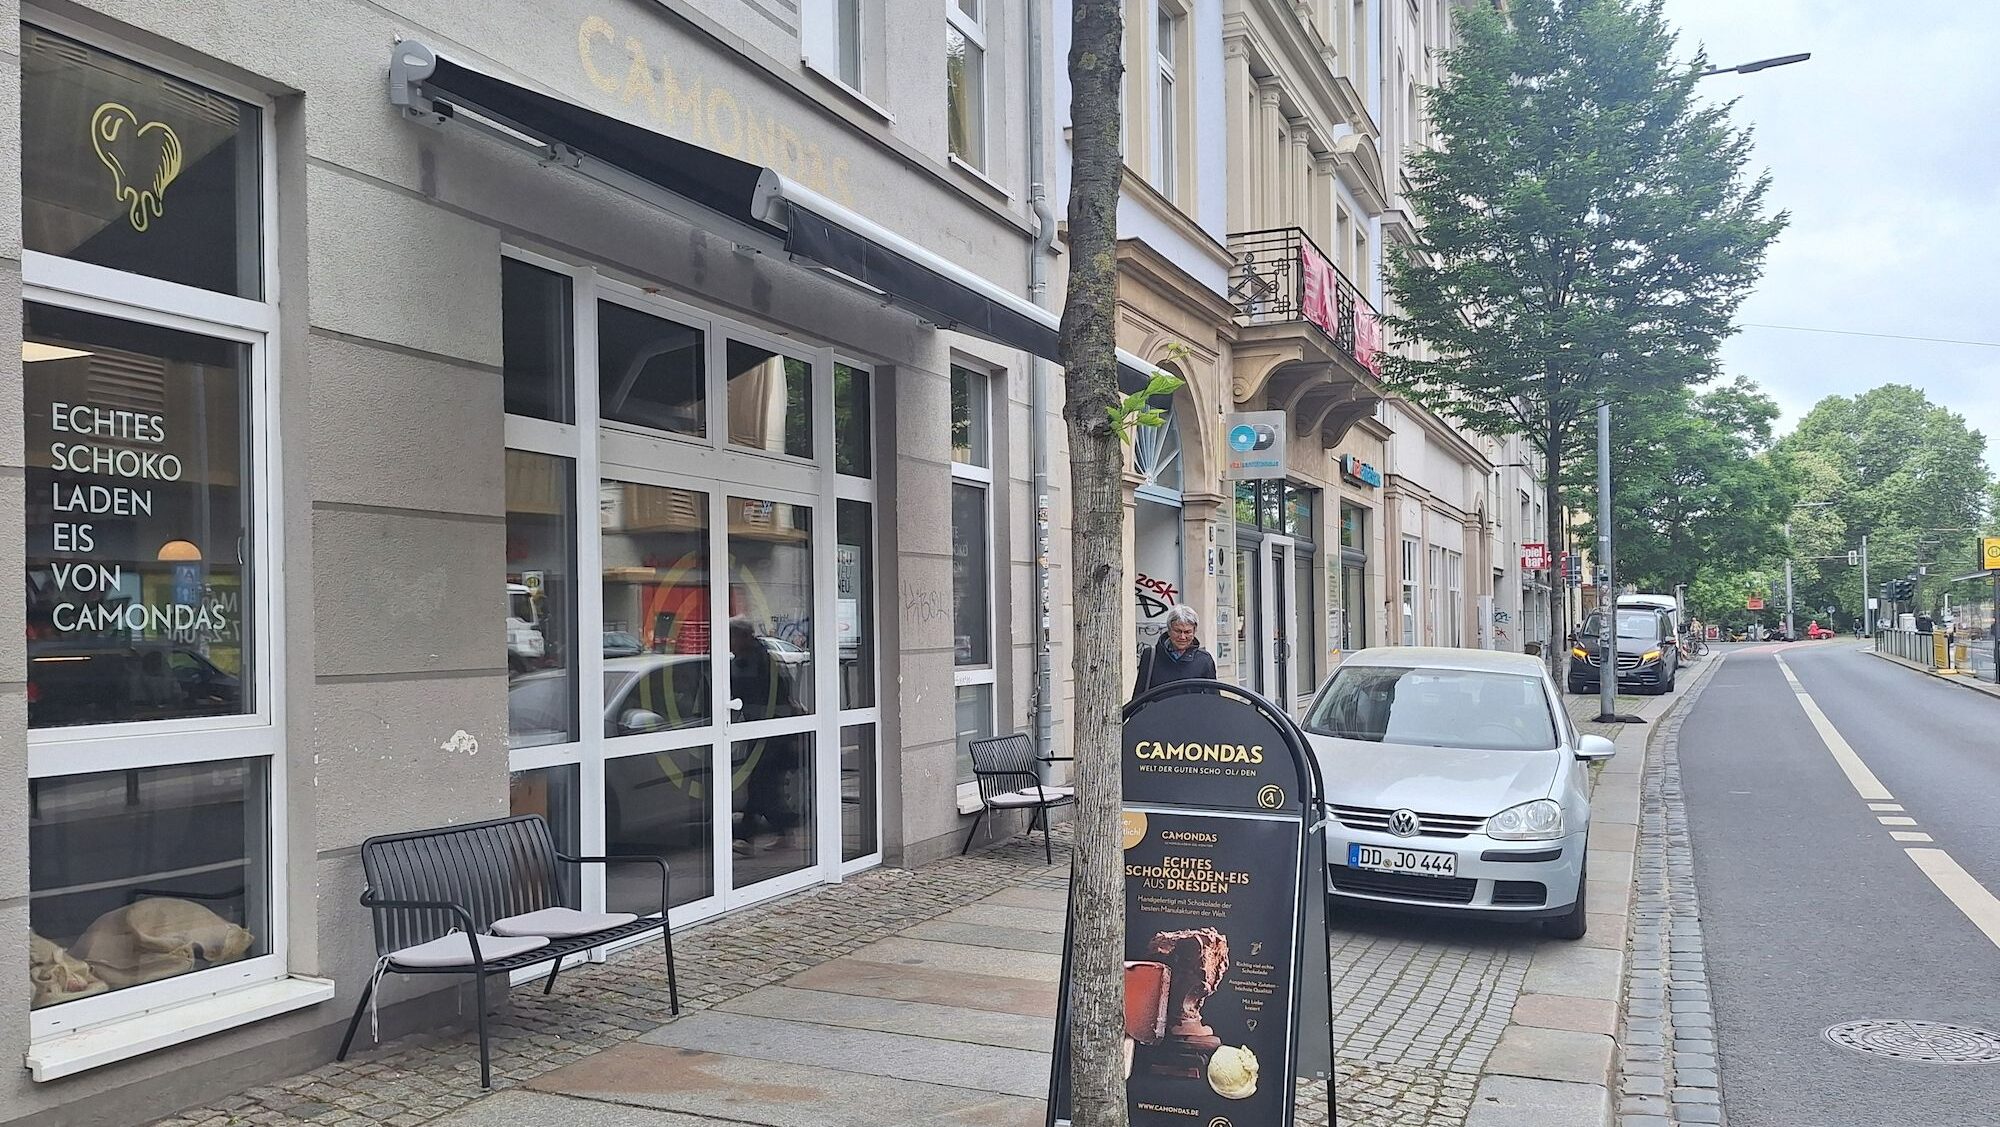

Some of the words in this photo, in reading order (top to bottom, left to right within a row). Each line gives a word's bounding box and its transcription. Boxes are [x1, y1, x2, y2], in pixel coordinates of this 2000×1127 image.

[51, 402, 165, 443] ECHTES
[51, 442, 182, 481] SCHOKO
[52, 482, 152, 517] LADEN
[52, 522, 95, 553] EIS
[51, 562, 121, 593] VON
[52, 602, 226, 631] CAMONDAS
[1135, 741, 1263, 764] CAMONDAS
[1174, 766, 1198, 774] GUTEN
[1162, 830, 1218, 843] CAMONDAS
[1163, 856, 1212, 870] ECHTES
[1360, 848, 1382, 865] DD
[1394, 852, 1416, 869] JO
[1420, 855, 1453, 872] 444
[1125, 864, 1250, 884] SCHOKOLADEN-EIS
[1143, 878, 1165, 889] AUS
[1167, 879, 1228, 894] DRESDEN
[1187, 898, 1221, 909] Schokolade
[1137, 1102, 1200, 1117] WWW.CAMONDAS.DE
